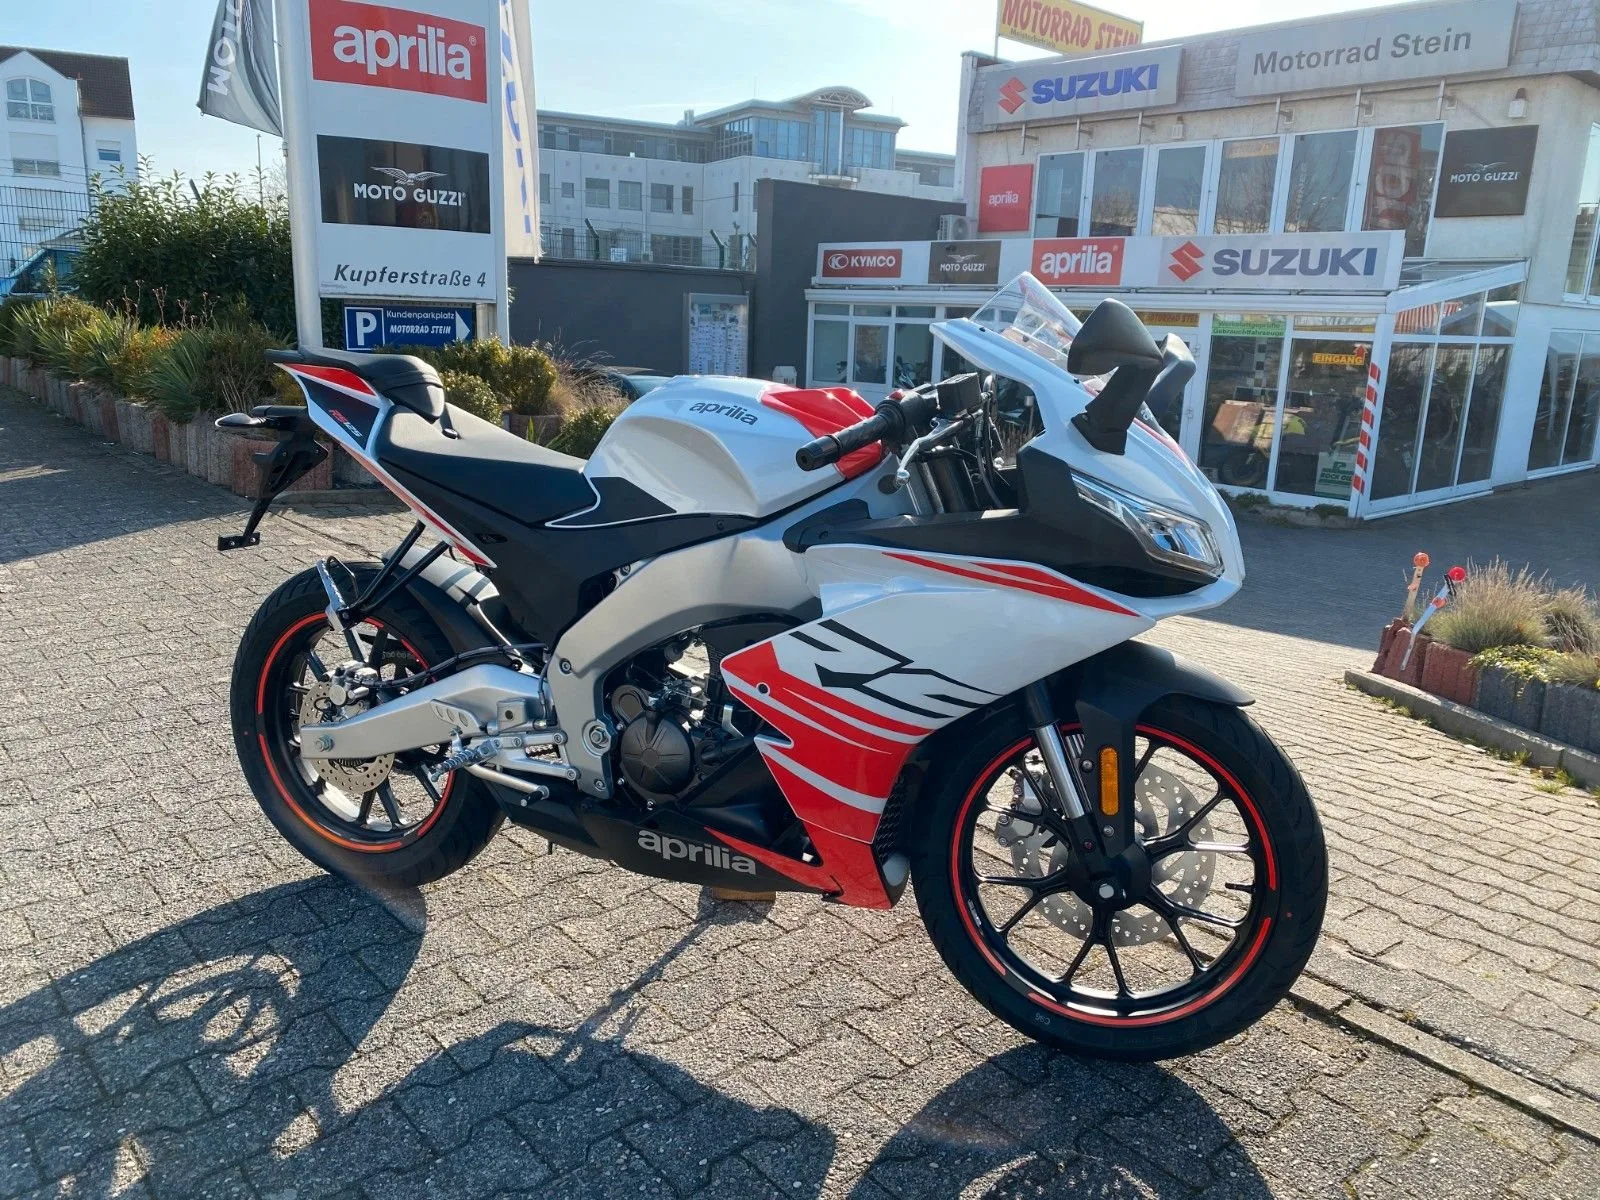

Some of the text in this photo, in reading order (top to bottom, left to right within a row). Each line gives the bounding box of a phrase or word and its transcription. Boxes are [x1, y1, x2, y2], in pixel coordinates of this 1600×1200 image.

[1002, 0, 1091, 48] MOTORRAD
[333, 24, 472, 81] aprilia
[1253, 28, 1472, 76] Motorrad Stein
[1031, 64, 1160, 105] SUZUKI
[1450, 171, 1519, 184] MOTO GUZZI
[353, 183, 463, 207] MOTO GUZZI
[988, 190, 1020, 207] aprilia
[850, 255, 896, 268] KYMCO
[940, 263, 985, 273] MOTO GUZZI
[1040, 244, 1113, 279] aprilia
[1212, 247, 1378, 277] SUZUKI
[334, 264, 487, 288] Kupferstraße 4
[386, 310, 455, 320] Kundenparkplatz
[355, 311, 378, 346] P
[389, 324, 451, 335] MOTORRAD STEIN
[1315, 354, 1363, 365] EINGANG
[689, 402, 759, 425] aprilia
[637, 829, 757, 875] aprilia
